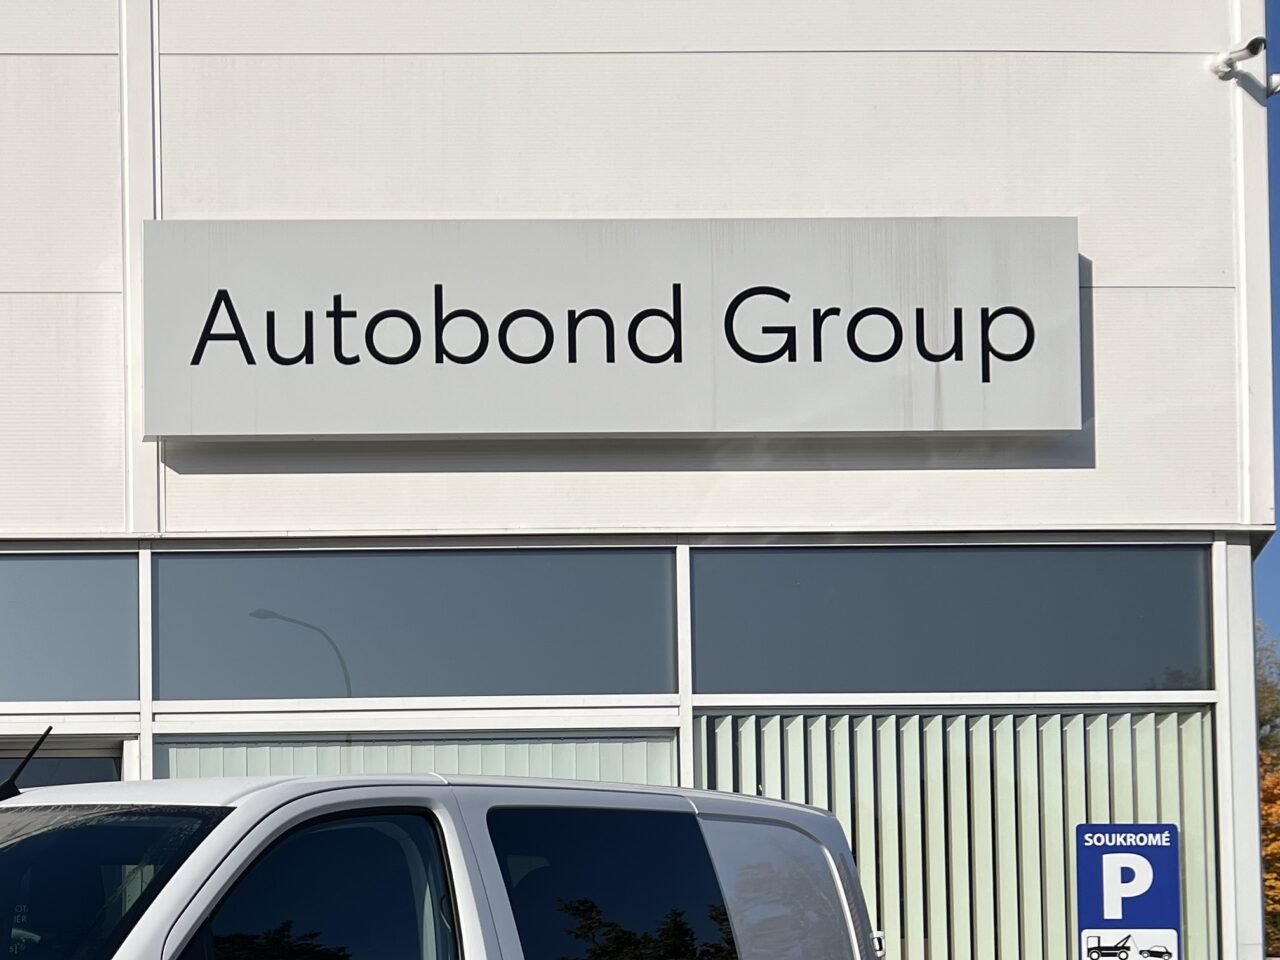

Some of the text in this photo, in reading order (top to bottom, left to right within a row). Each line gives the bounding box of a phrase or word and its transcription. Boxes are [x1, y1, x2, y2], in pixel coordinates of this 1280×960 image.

[189, 283, 1036, 383] Autobond Group
[1084, 830, 1170, 846] SOUKROMÉ
[1102, 853, 1154, 919] P
